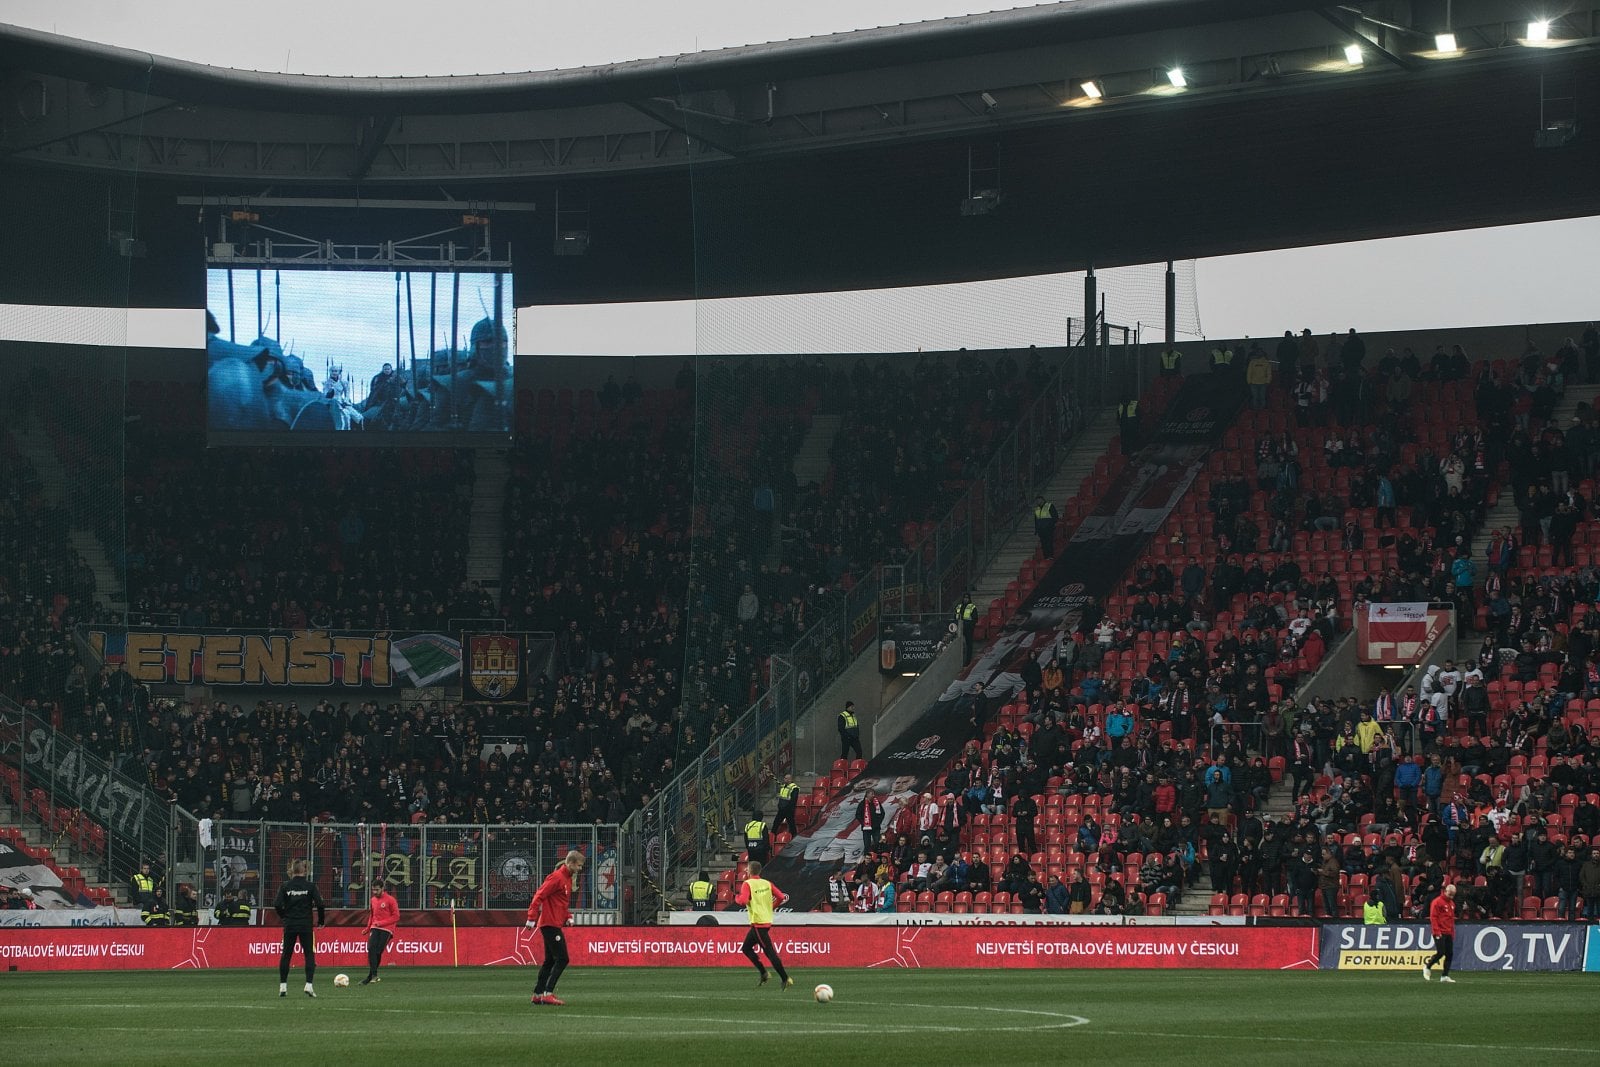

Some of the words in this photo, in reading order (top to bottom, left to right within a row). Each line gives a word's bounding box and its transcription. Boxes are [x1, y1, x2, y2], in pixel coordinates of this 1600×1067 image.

[1417, 626, 1439, 657] PLAST
[56, 944, 99, 957] MUZEUM
[101, 944, 108, 957] V
[110, 941, 144, 957] ČESKU!
[386, 942, 394, 953] V
[396, 939, 443, 953] ČESKU!
[588, 939, 642, 954] NEJVETŠÍ
[644, 939, 714, 954] FOTBALOVÉ
[774, 942, 783, 954] V
[786, 939, 831, 954] ČESKU!
[976, 940, 1034, 955] NEJVETŠÍ
[1037, 940, 1113, 955] FOTBALOVÉ
[1117, 943, 1175, 955] MUZEUM
[1178, 943, 1188, 955] V
[1191, 940, 1239, 956] ČESKU!
[1522, 933, 1571, 963] TV
